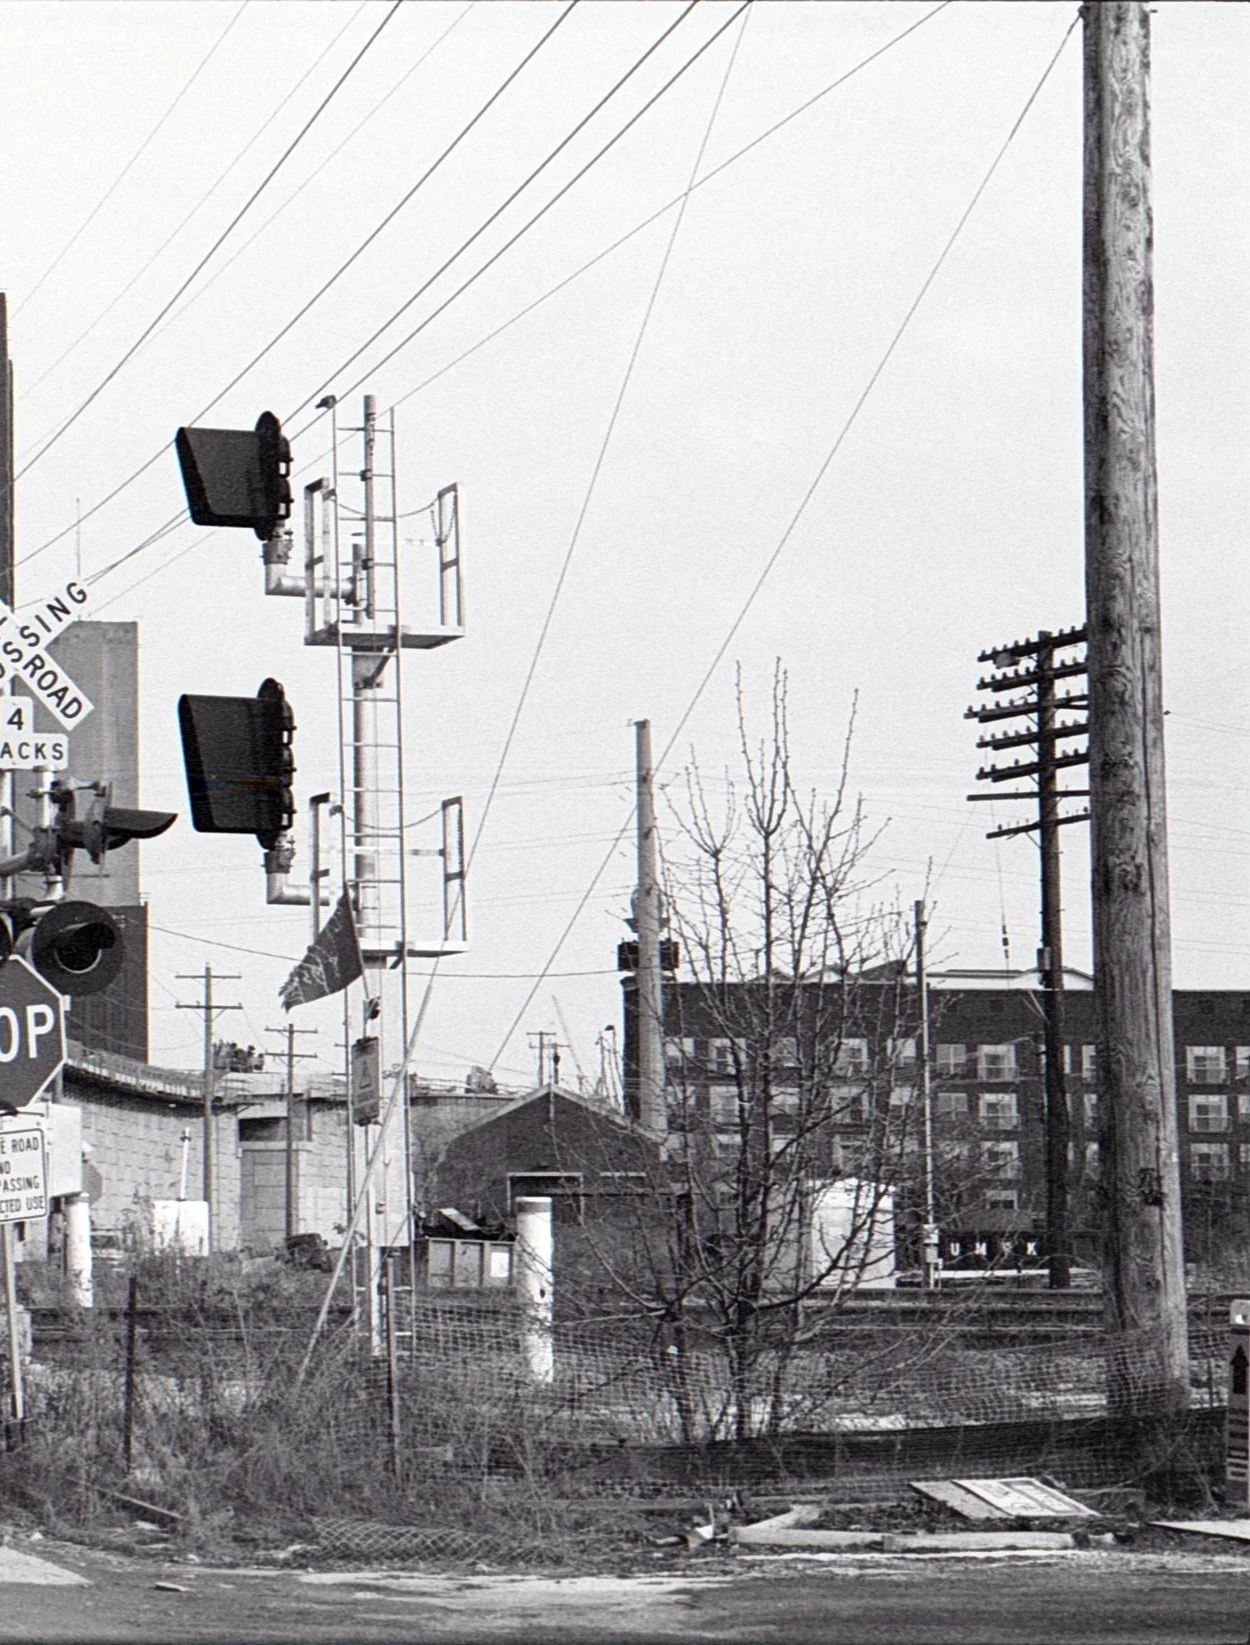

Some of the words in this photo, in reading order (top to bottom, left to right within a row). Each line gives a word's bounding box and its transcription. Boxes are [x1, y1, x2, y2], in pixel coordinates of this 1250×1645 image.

[7, 708, 24, 731] 4
[11, 1137, 39, 1152] ROAD
[26, 1196, 45, 1211] USE
